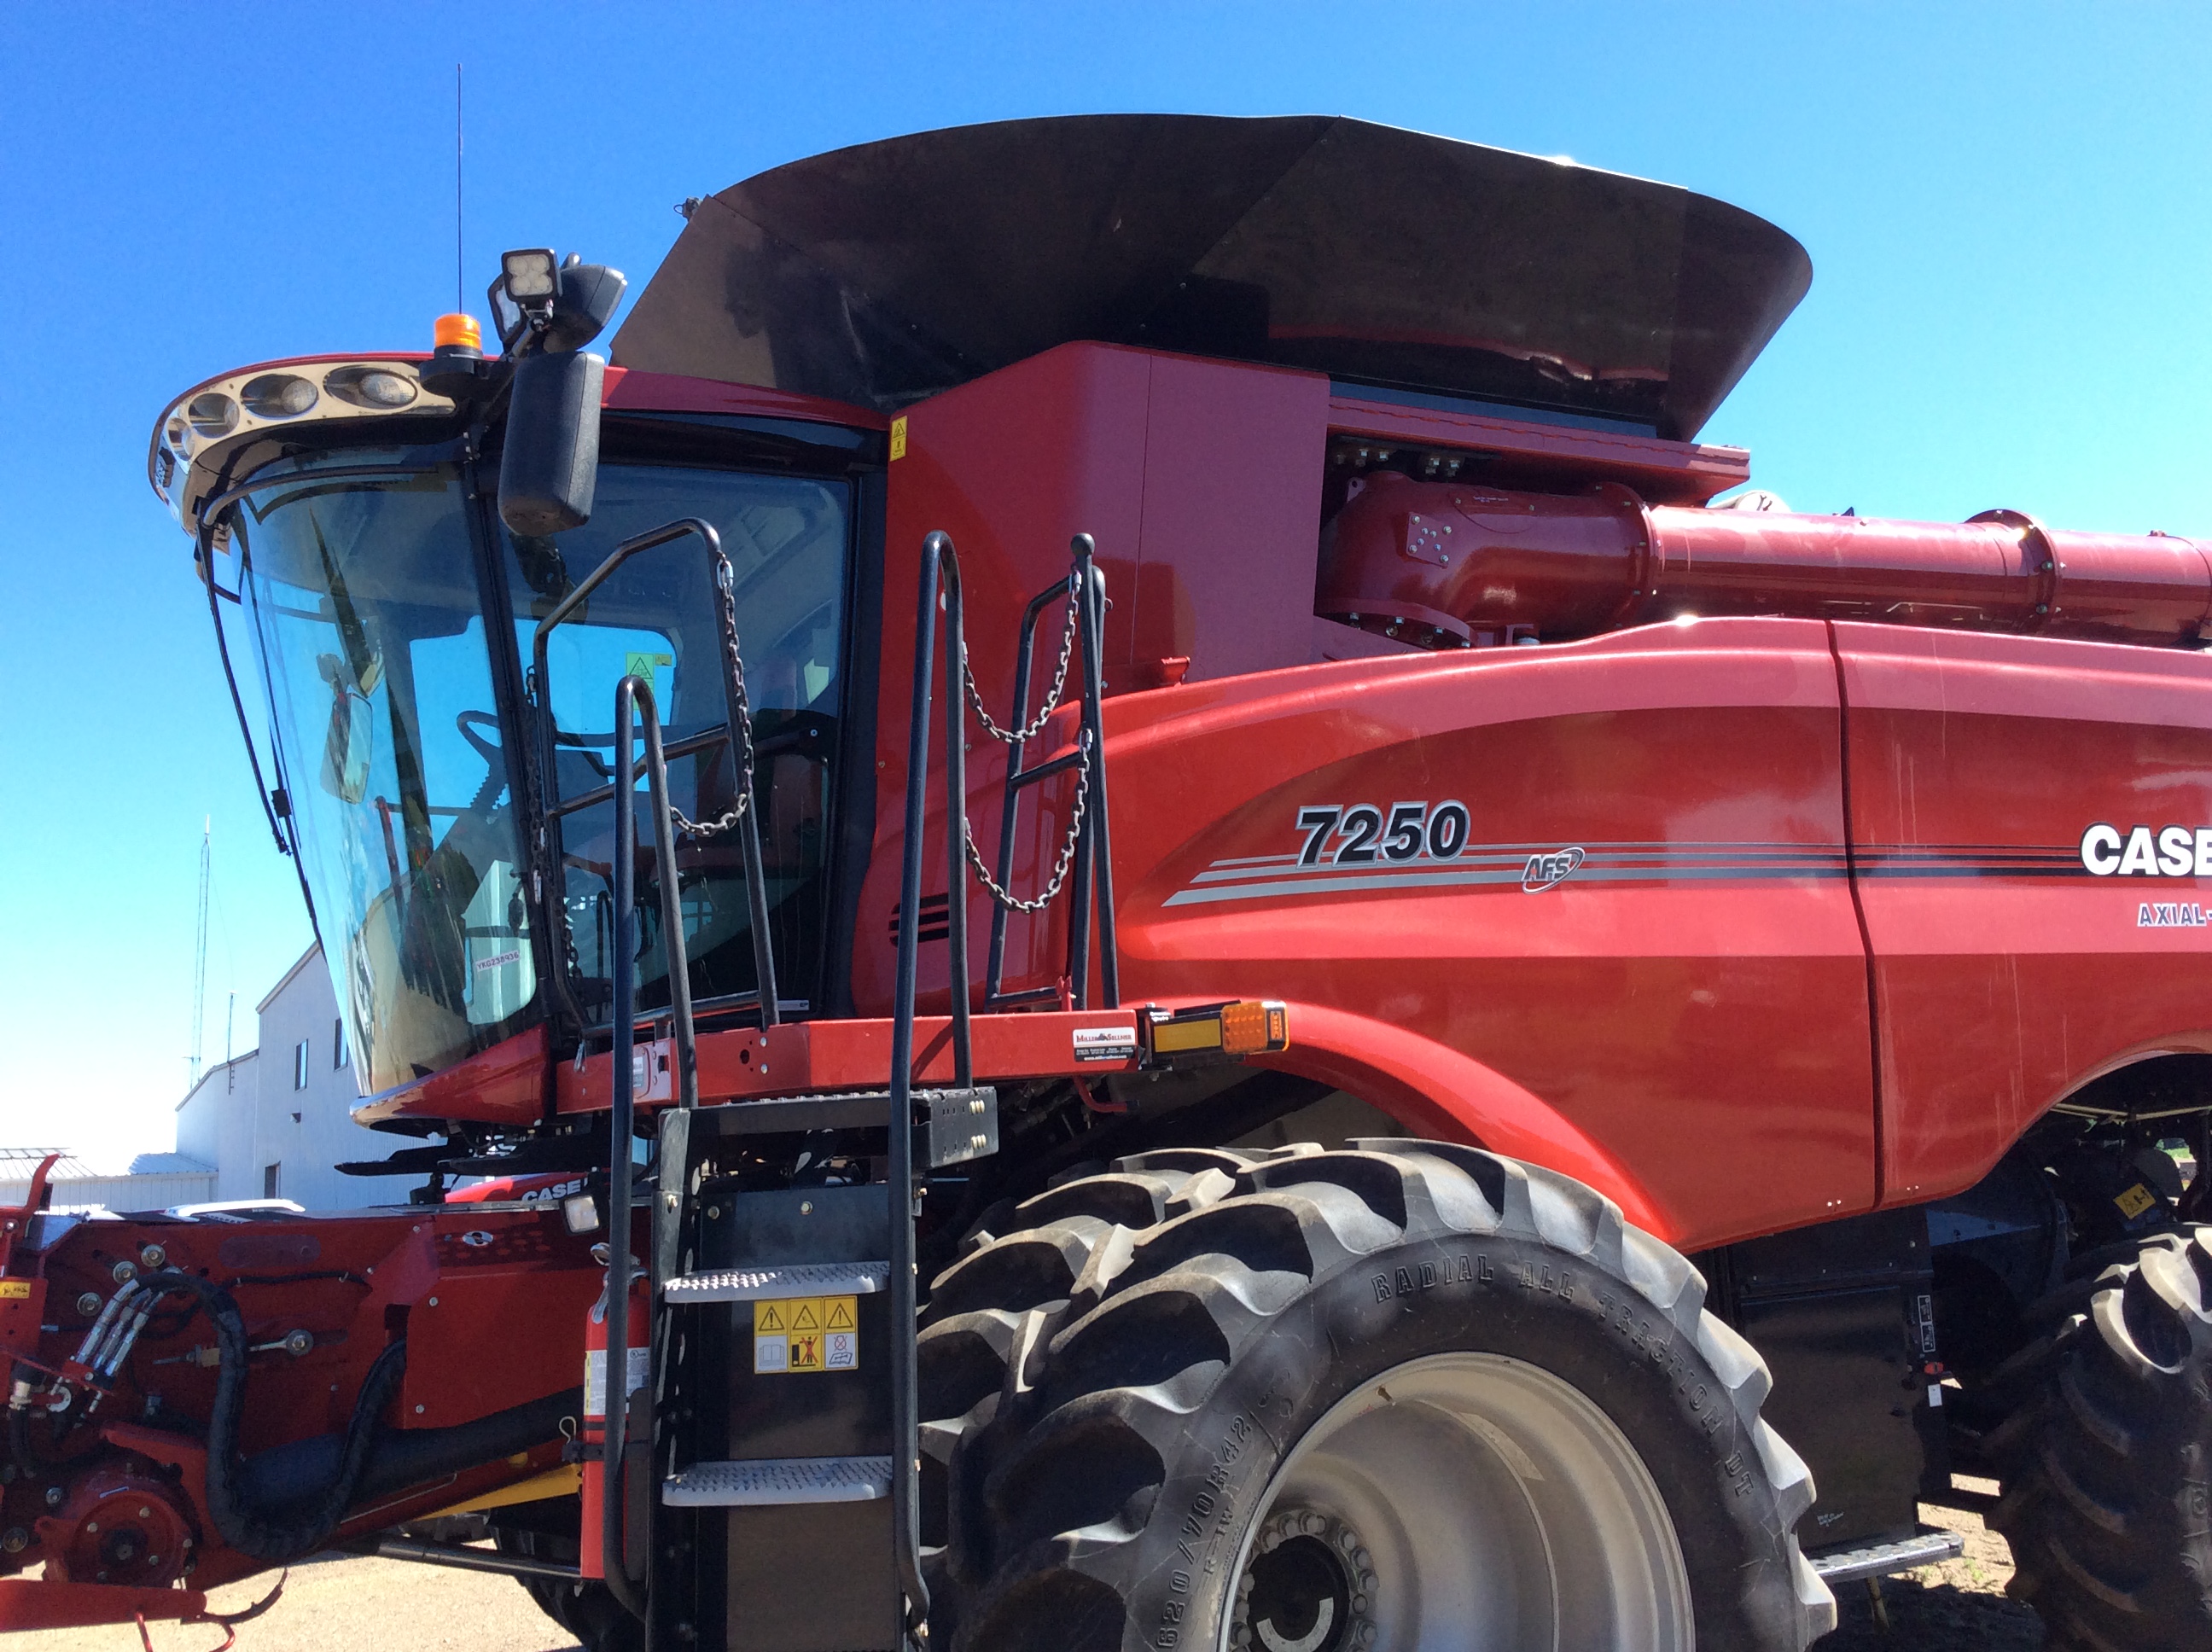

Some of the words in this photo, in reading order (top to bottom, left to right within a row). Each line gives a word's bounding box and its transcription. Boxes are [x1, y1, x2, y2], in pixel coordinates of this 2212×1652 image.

[1295, 799, 1470, 868] 7250
[2080, 822, 2212, 877] CASE
[1521, 853, 1573, 882] AFS
[521, 1179, 581, 1201] CASE
[1372, 1254, 1493, 1304] RADIAL
[1519, 1261, 1575, 1302] ALL
[1598, 1292, 1722, 1437] TRACTION
